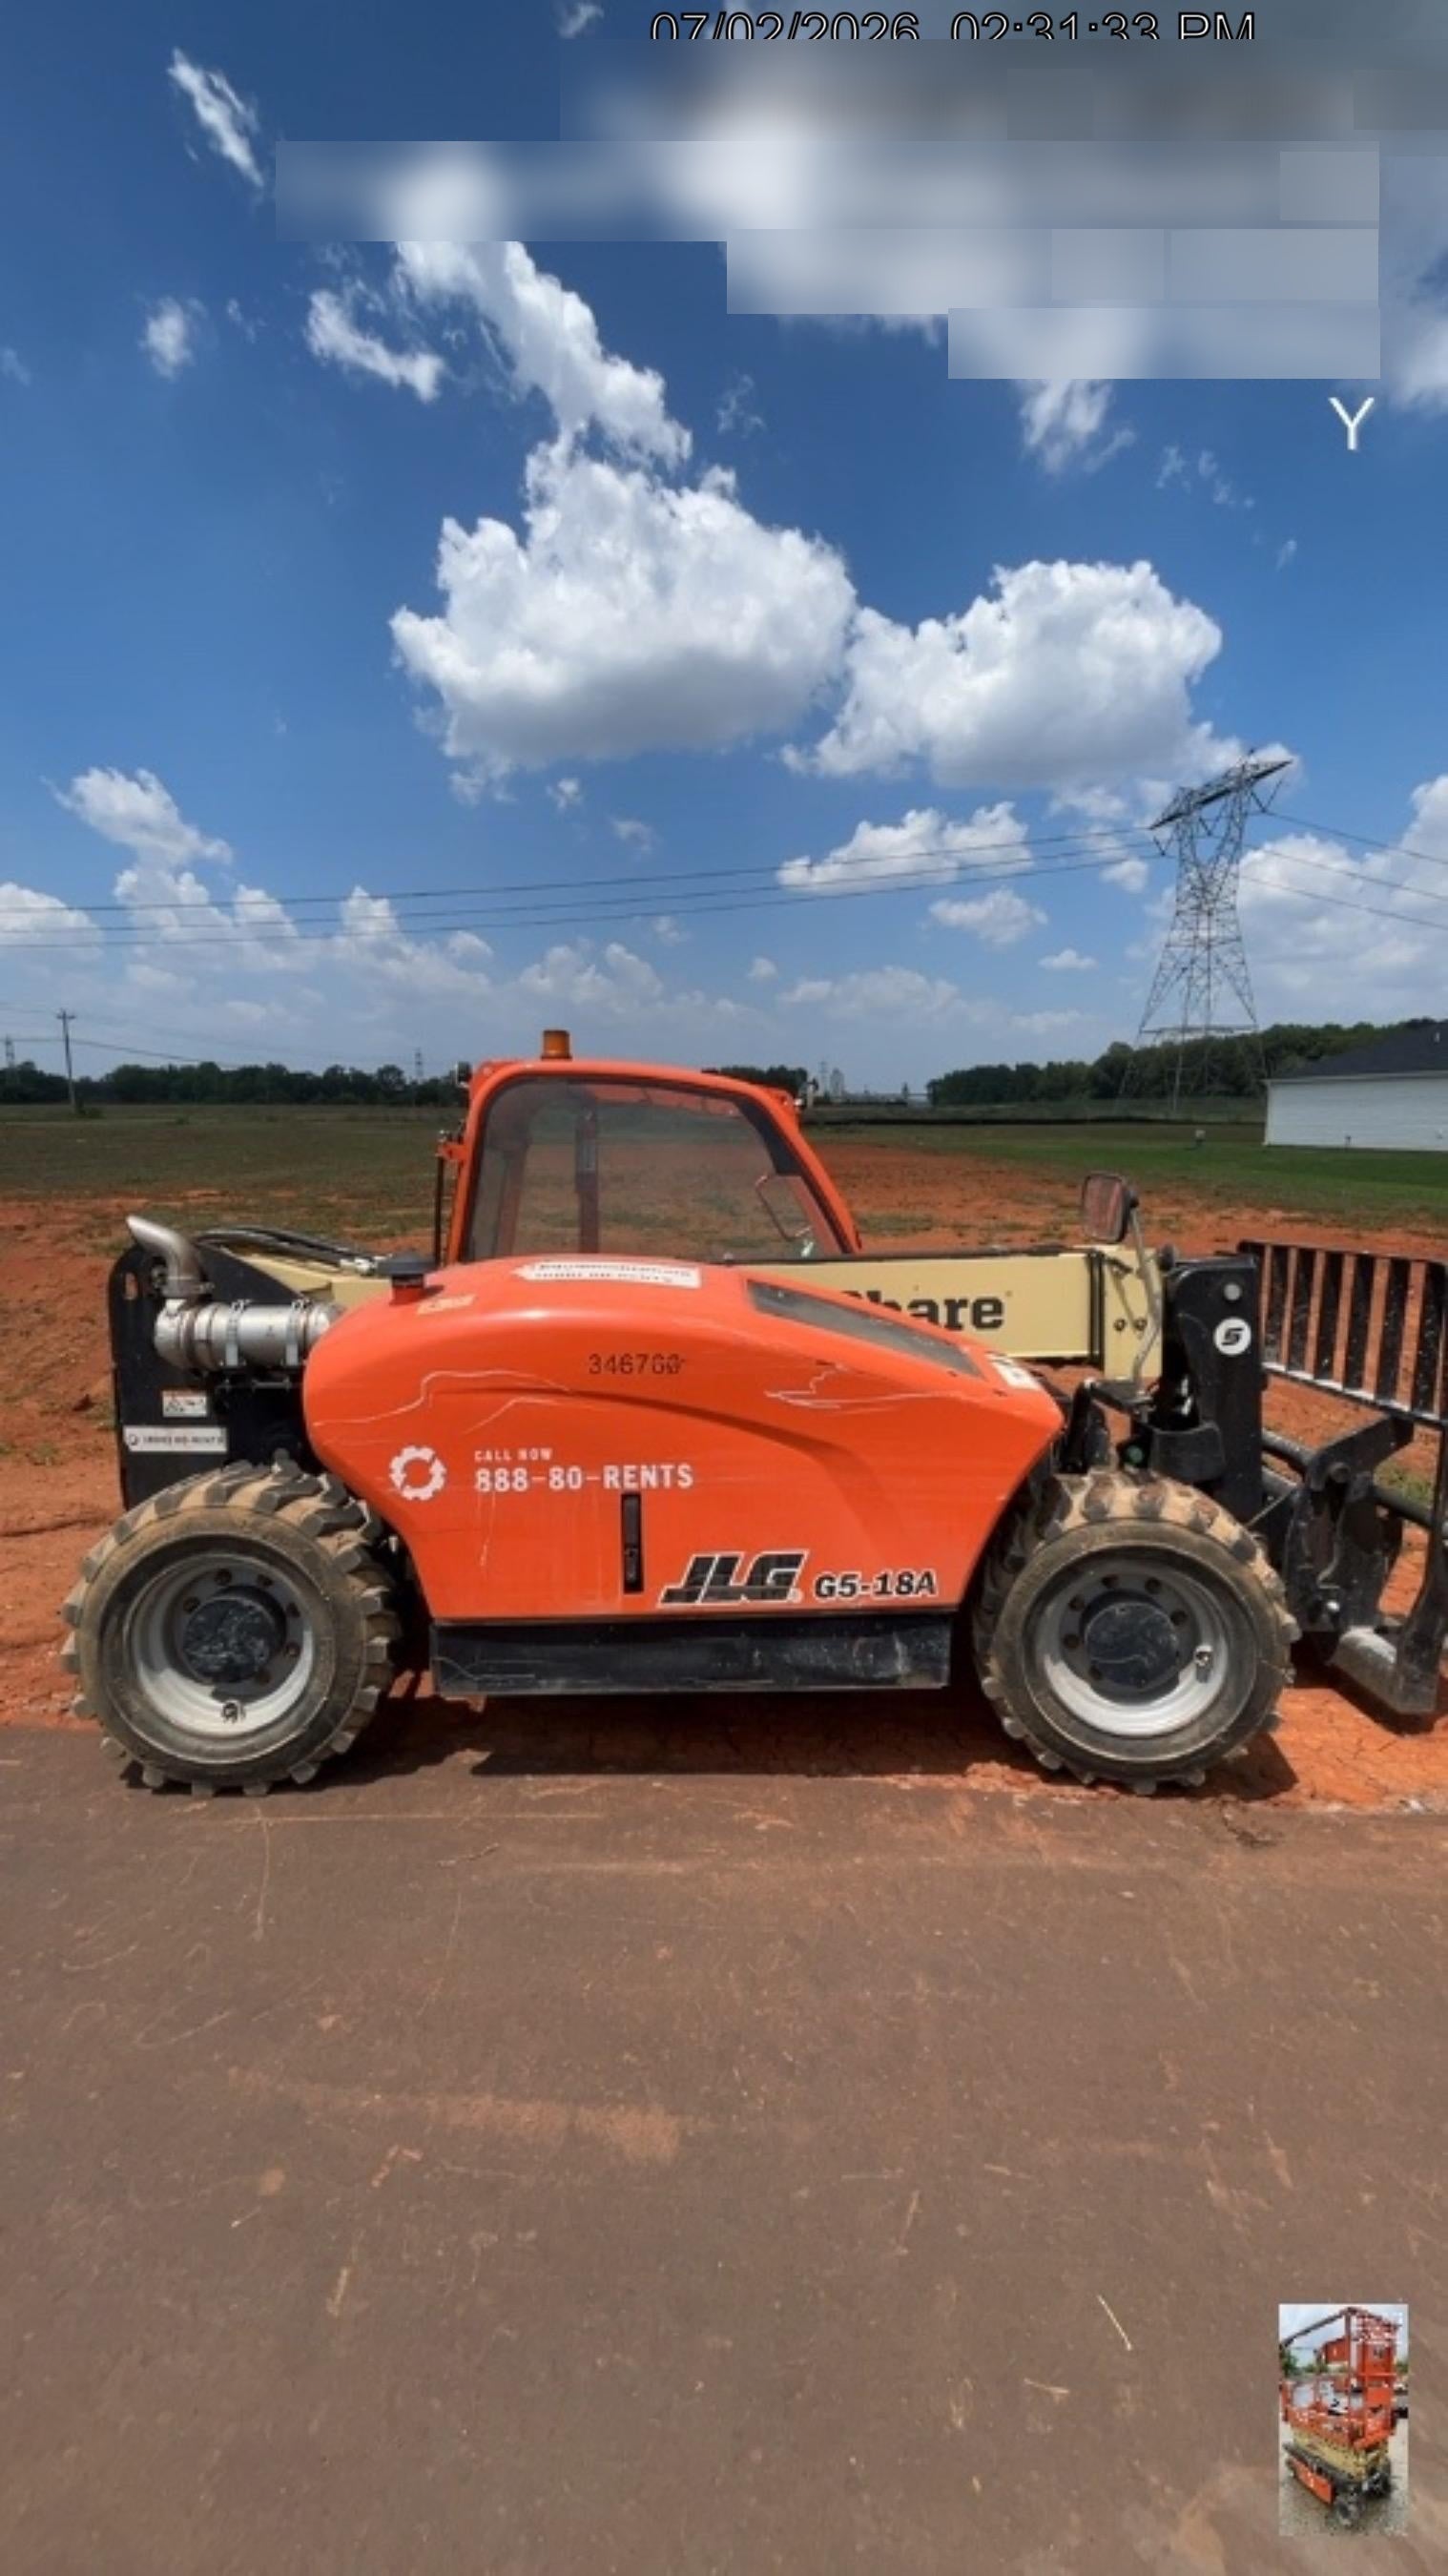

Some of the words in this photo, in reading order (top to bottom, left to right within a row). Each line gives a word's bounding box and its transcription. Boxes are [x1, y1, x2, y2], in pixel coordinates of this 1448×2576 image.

[475, 1449, 512, 1462] CALL
[518, 1447, 553, 1461] NOW
[475, 1464, 694, 1492] 888-80-RENTS
[658, 1549, 809, 1607] JLG
[814, 1569, 938, 1600] G5-18A
